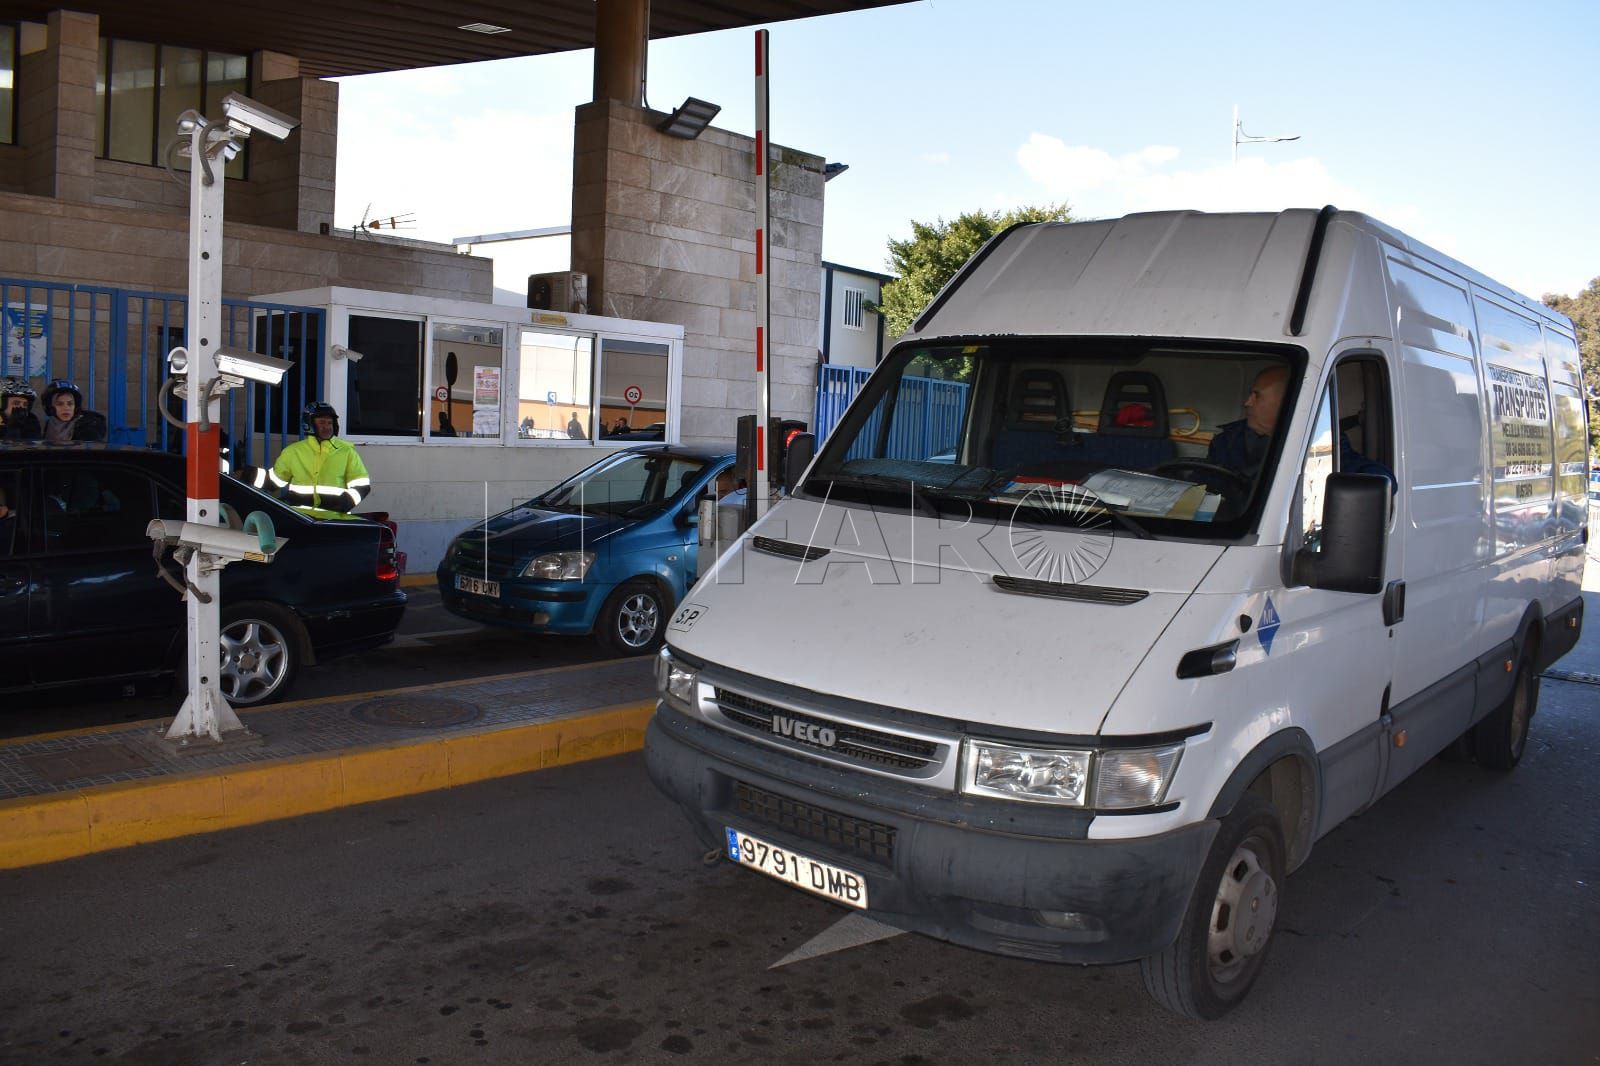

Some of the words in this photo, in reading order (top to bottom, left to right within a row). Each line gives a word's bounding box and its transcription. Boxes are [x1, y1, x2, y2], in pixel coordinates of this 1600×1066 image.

[1493, 384, 1547, 420] TRANSPORTES
[675, 609, 700, 626] S.P.
[772, 714, 837, 747] IVECO
[742, 838, 800, 882] 9791
[810, 862, 861, 901] DMB
